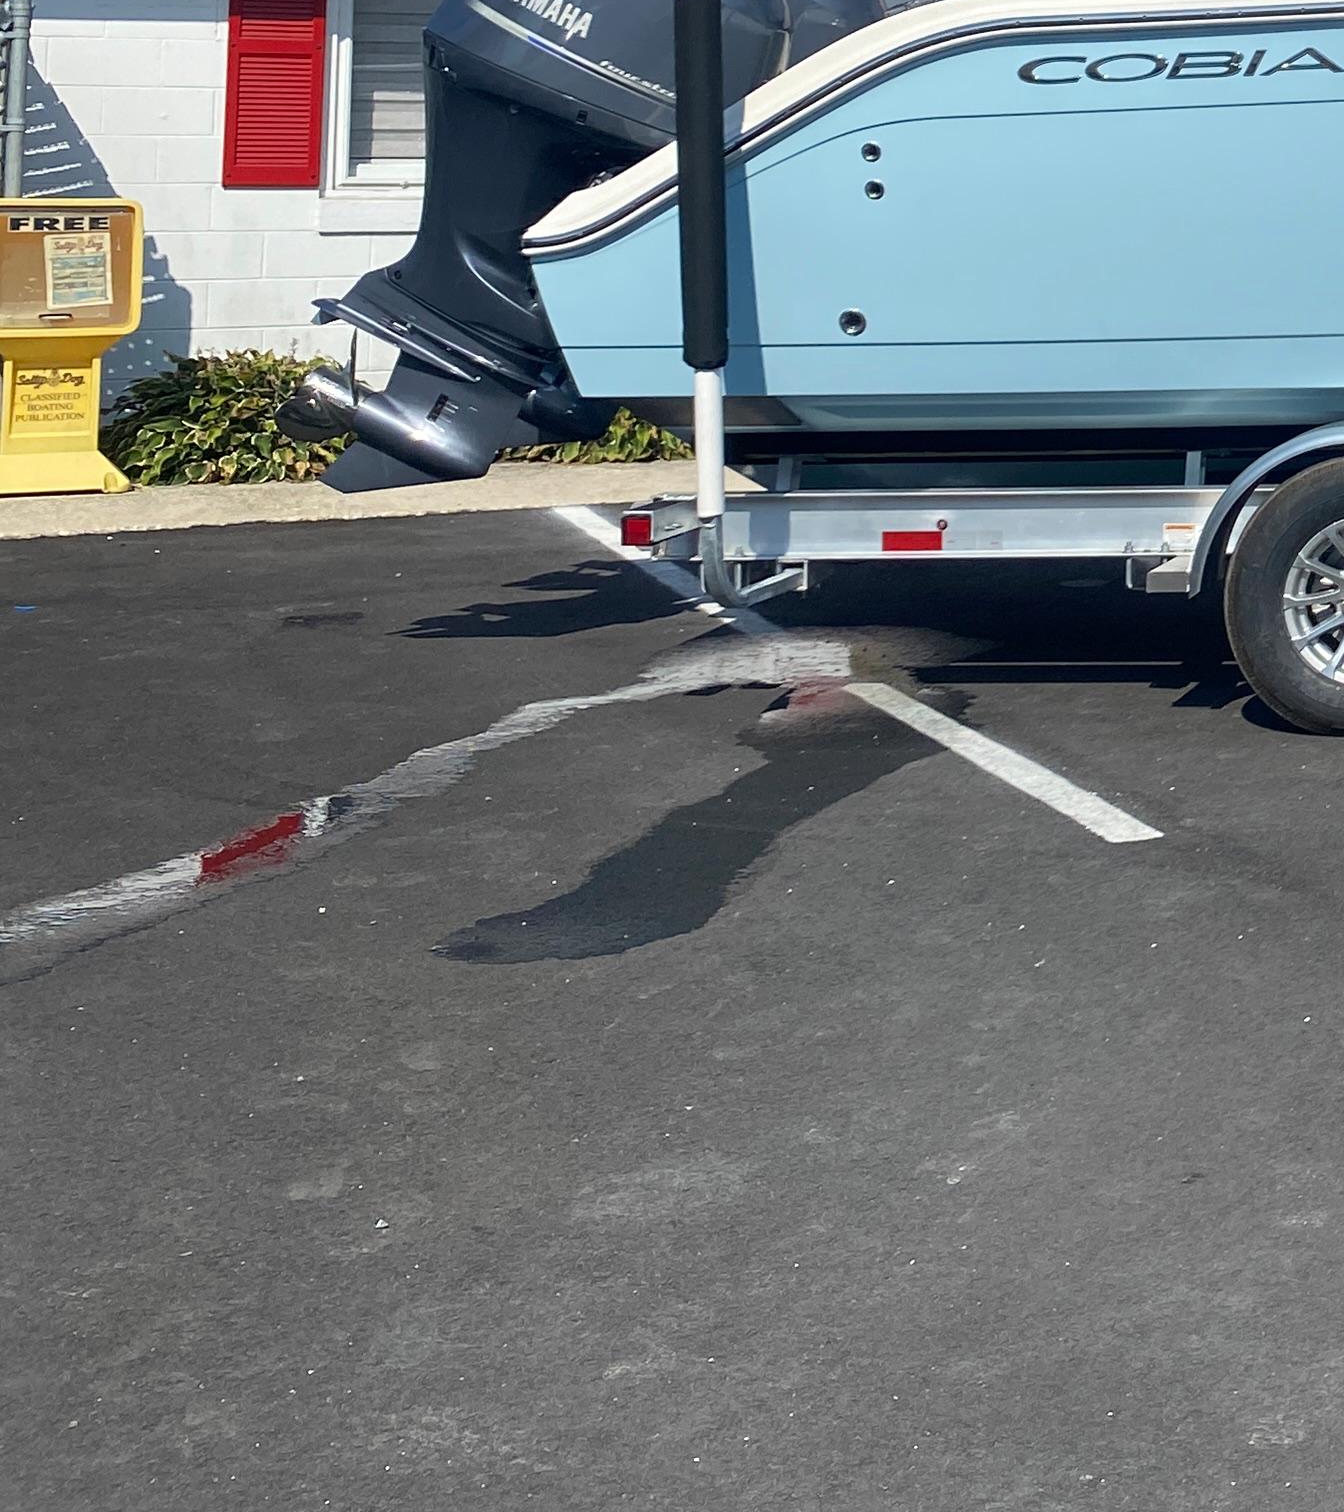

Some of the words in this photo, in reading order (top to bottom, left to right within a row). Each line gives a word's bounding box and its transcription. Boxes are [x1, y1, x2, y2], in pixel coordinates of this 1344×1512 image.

[10, 216, 109, 231] FREE
[20, 391, 81, 402] CLASSIFIED
[27, 402, 73, 412] BOATING
[15, 411, 85, 423] PUBLICATION
